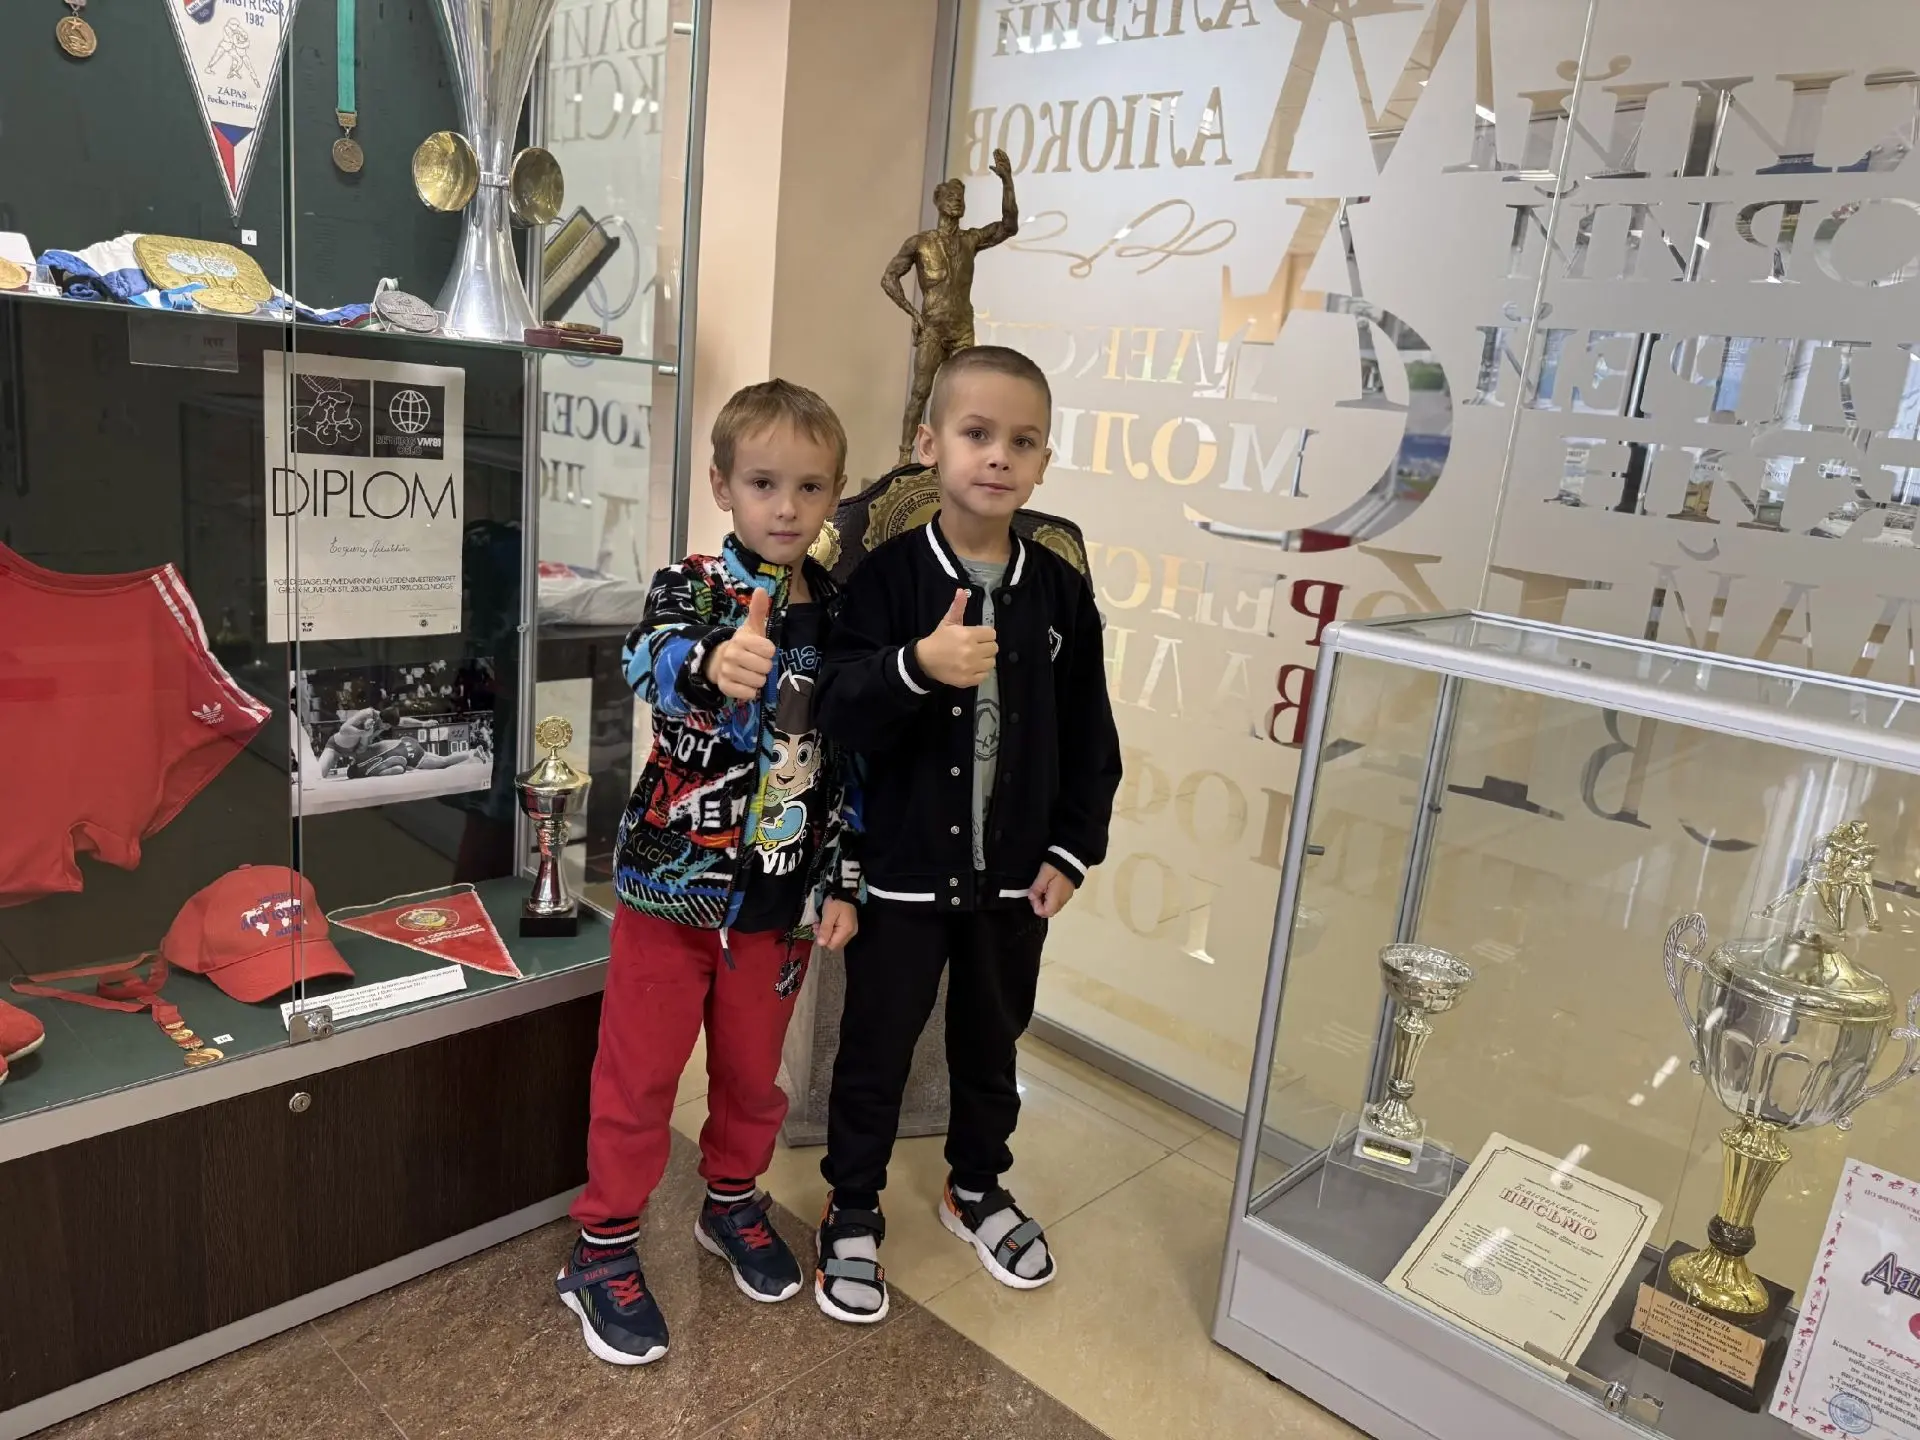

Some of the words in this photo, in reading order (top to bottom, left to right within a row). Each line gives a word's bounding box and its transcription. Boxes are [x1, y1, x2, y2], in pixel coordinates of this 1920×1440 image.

[245, 12, 265, 27] 1982
[272, 467, 457, 519] DIPLOM
[1498, 1187, 1598, 1241] ПИСЬМО
[1669, 1300, 1731, 1333] ПОБЕДИТЕЛЬ
